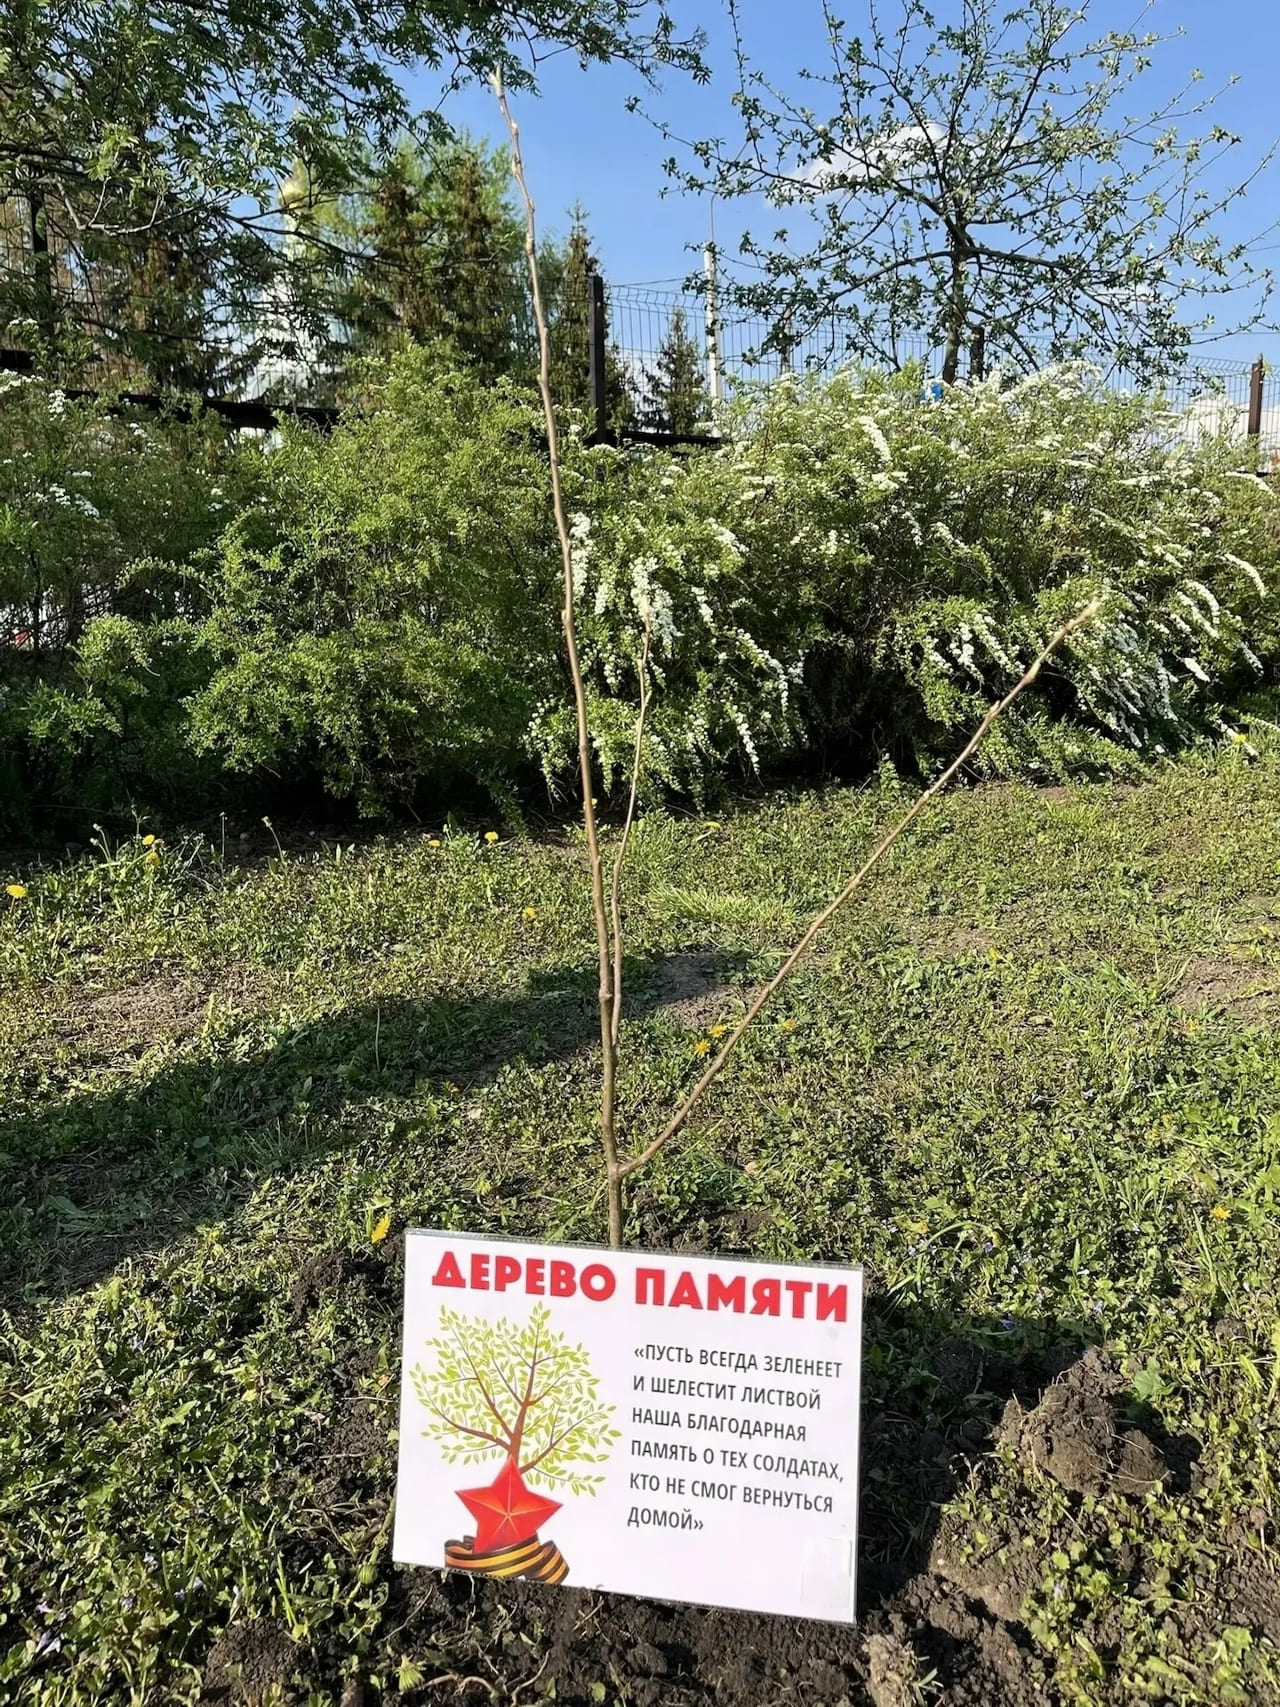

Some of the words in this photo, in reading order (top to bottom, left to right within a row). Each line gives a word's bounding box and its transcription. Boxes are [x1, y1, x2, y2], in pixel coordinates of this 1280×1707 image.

[432, 1252, 616, 1302] ДЕРЕВО
[635, 1268, 847, 1322] ПАМЯТИ
[634, 1344, 693, 1363] «ПУСТЬ
[699, 1349, 758, 1373] ВСЕГДА
[764, 1355, 842, 1378] ЗЕЛЕНЕЕТ
[633, 1375, 645, 1391] И
[651, 1377, 737, 1401] ШЕЛЕСТИТ
[741, 1384, 821, 1410] ЛИСТВОЙ
[632, 1407, 682, 1428] НАША
[687, 1413, 806, 1441] БЛАГОДАРНАЯ
[631, 1439, 697, 1463] ПАМЯТЬ
[703, 1448, 715, 1465] О
[720, 1450, 747, 1469] ТЕХ
[753, 1454, 843, 1482] СОЛДАТАХ,
[630, 1473, 660, 1492] КТО
[666, 1477, 685, 1495] НЕ
[691, 1480, 737, 1501] СМОГ
[743, 1486, 833, 1513] ВЕРНУТЬСЯ
[627, 1504, 705, 1530] ДОМОЙ»
